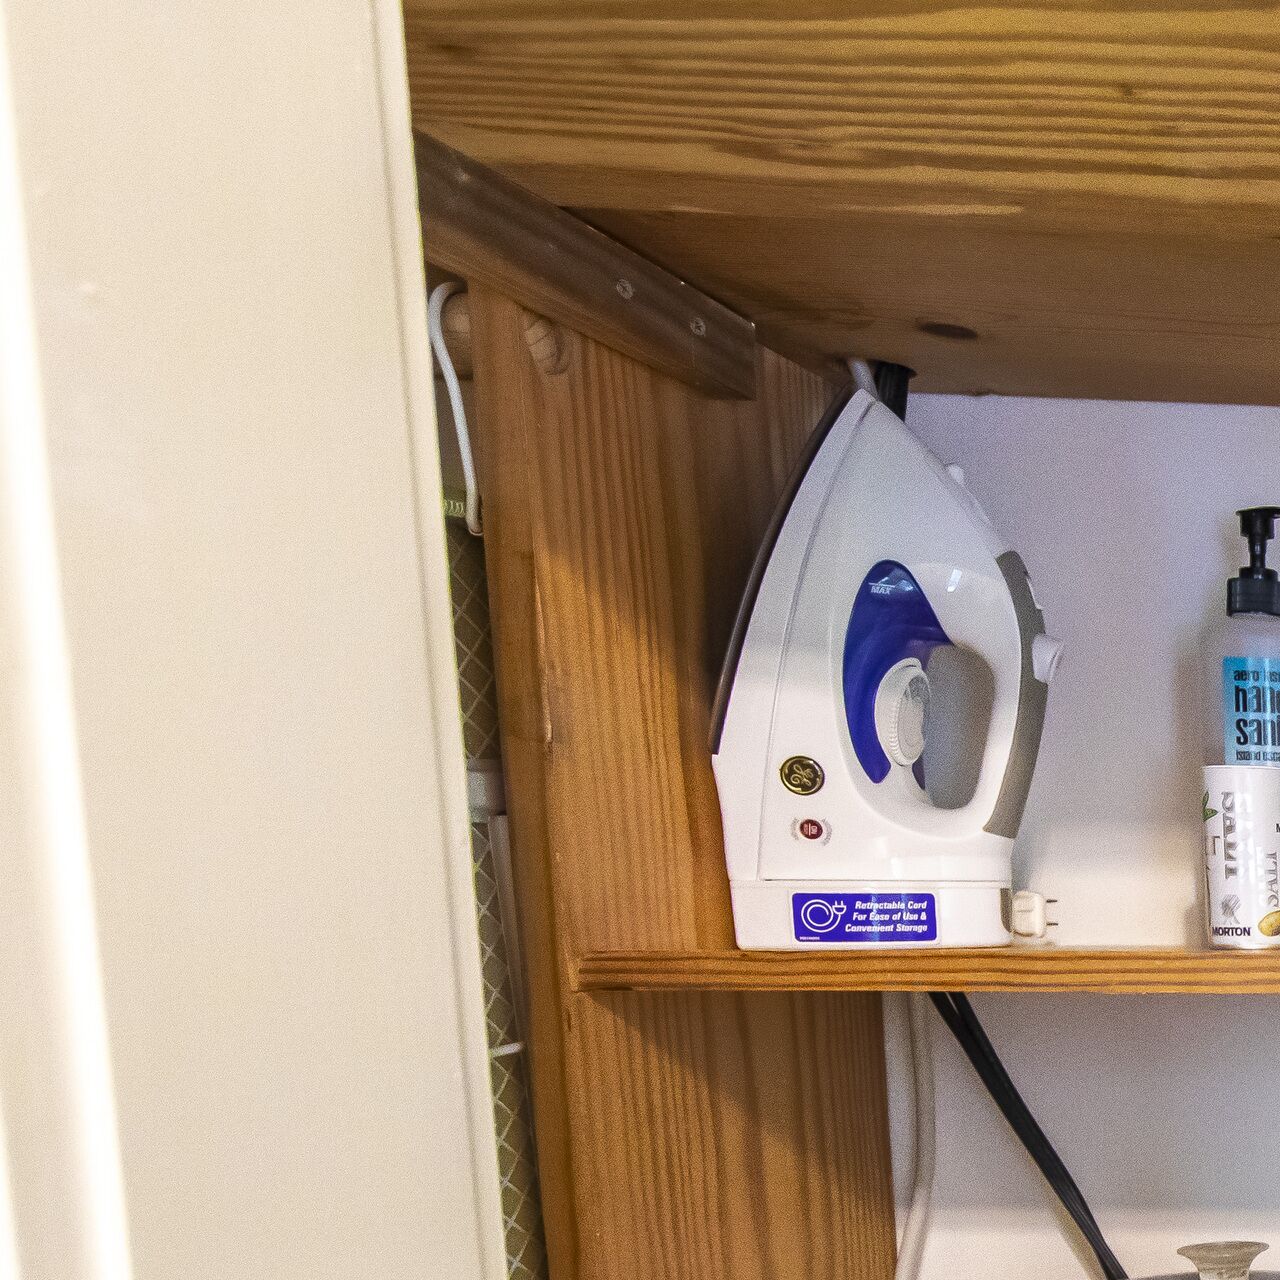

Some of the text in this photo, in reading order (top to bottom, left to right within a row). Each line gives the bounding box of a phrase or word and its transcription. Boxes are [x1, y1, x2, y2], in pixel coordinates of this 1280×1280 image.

[870, 585, 892, 594] MAX
[855, 900, 927, 910] Retractable Cord
[852, 911, 927, 920] For Ease of Use &
[845, 924, 928, 933] Convenient Storage
[1212, 927, 1251, 937] MORTON
